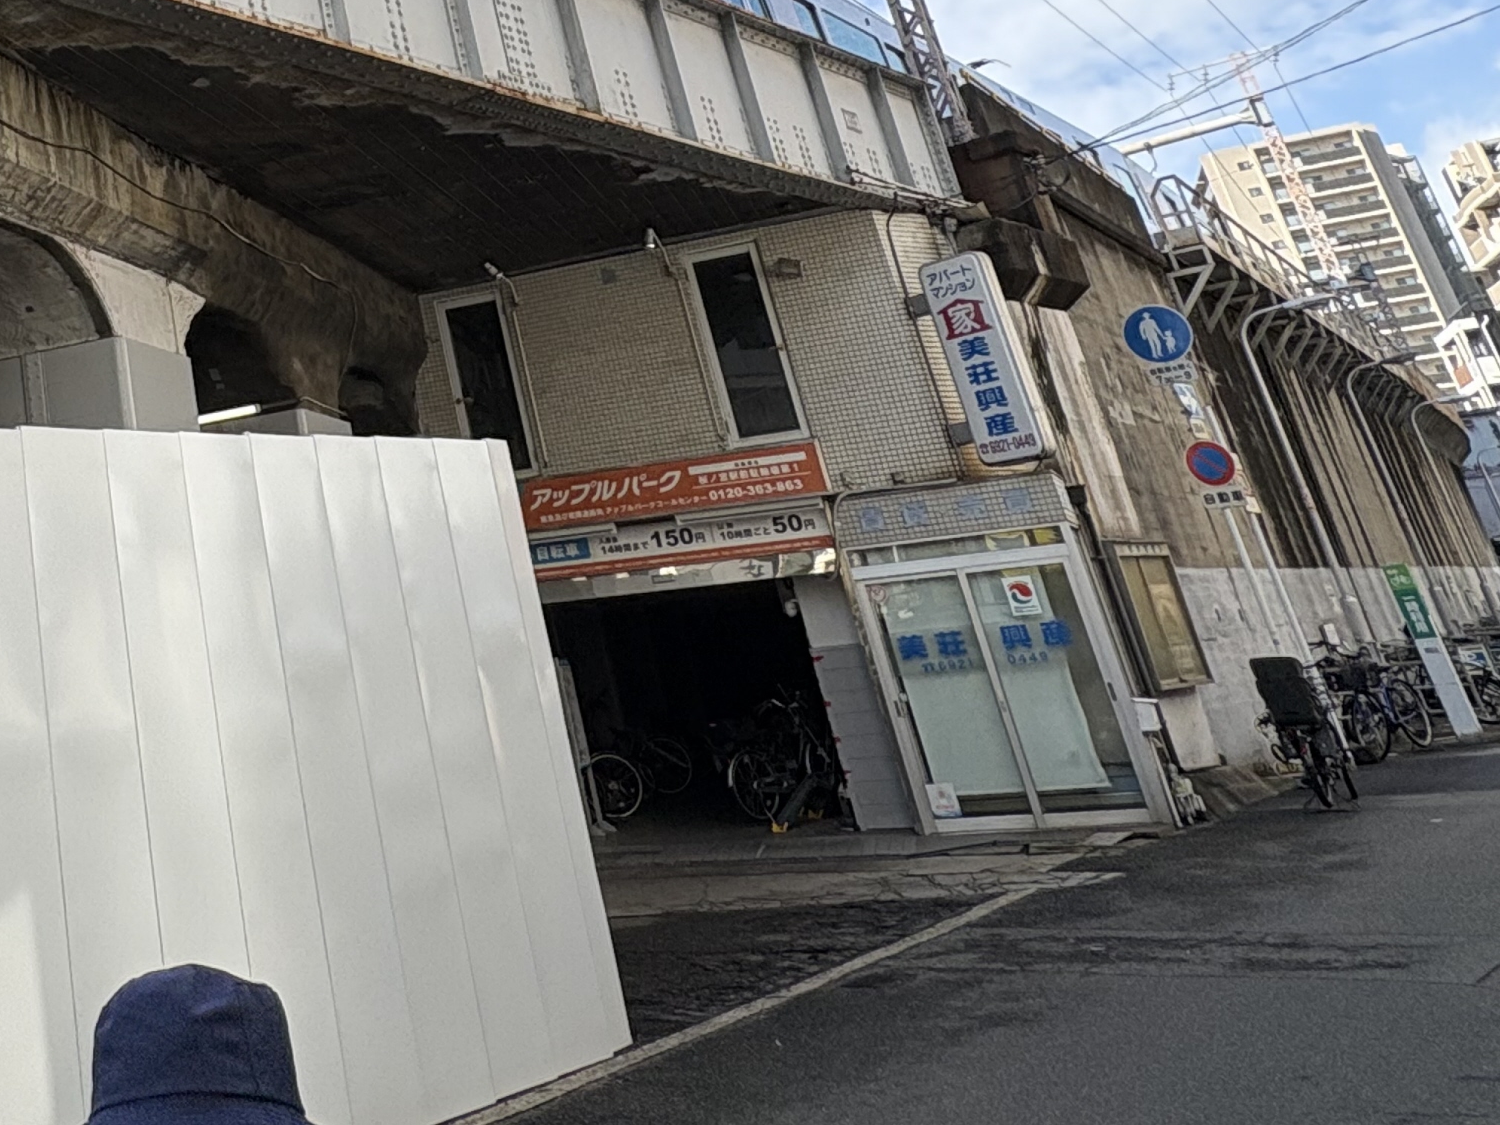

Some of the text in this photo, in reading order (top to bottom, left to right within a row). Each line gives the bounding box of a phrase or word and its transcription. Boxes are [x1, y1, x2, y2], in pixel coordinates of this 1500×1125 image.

[926, 265, 972, 286] アパート
[929, 278, 975, 299] マンション
[947, 302, 981, 335] 家
[957, 336, 1019, 437] 美荘興産
[530, 470, 682, 511] アップルパーク
[709, 479, 803, 501] 0120-363-863
[772, 514, 816, 534] 50円
[651, 527, 706, 549] 150円
[536, 542, 580, 561] 自転車
